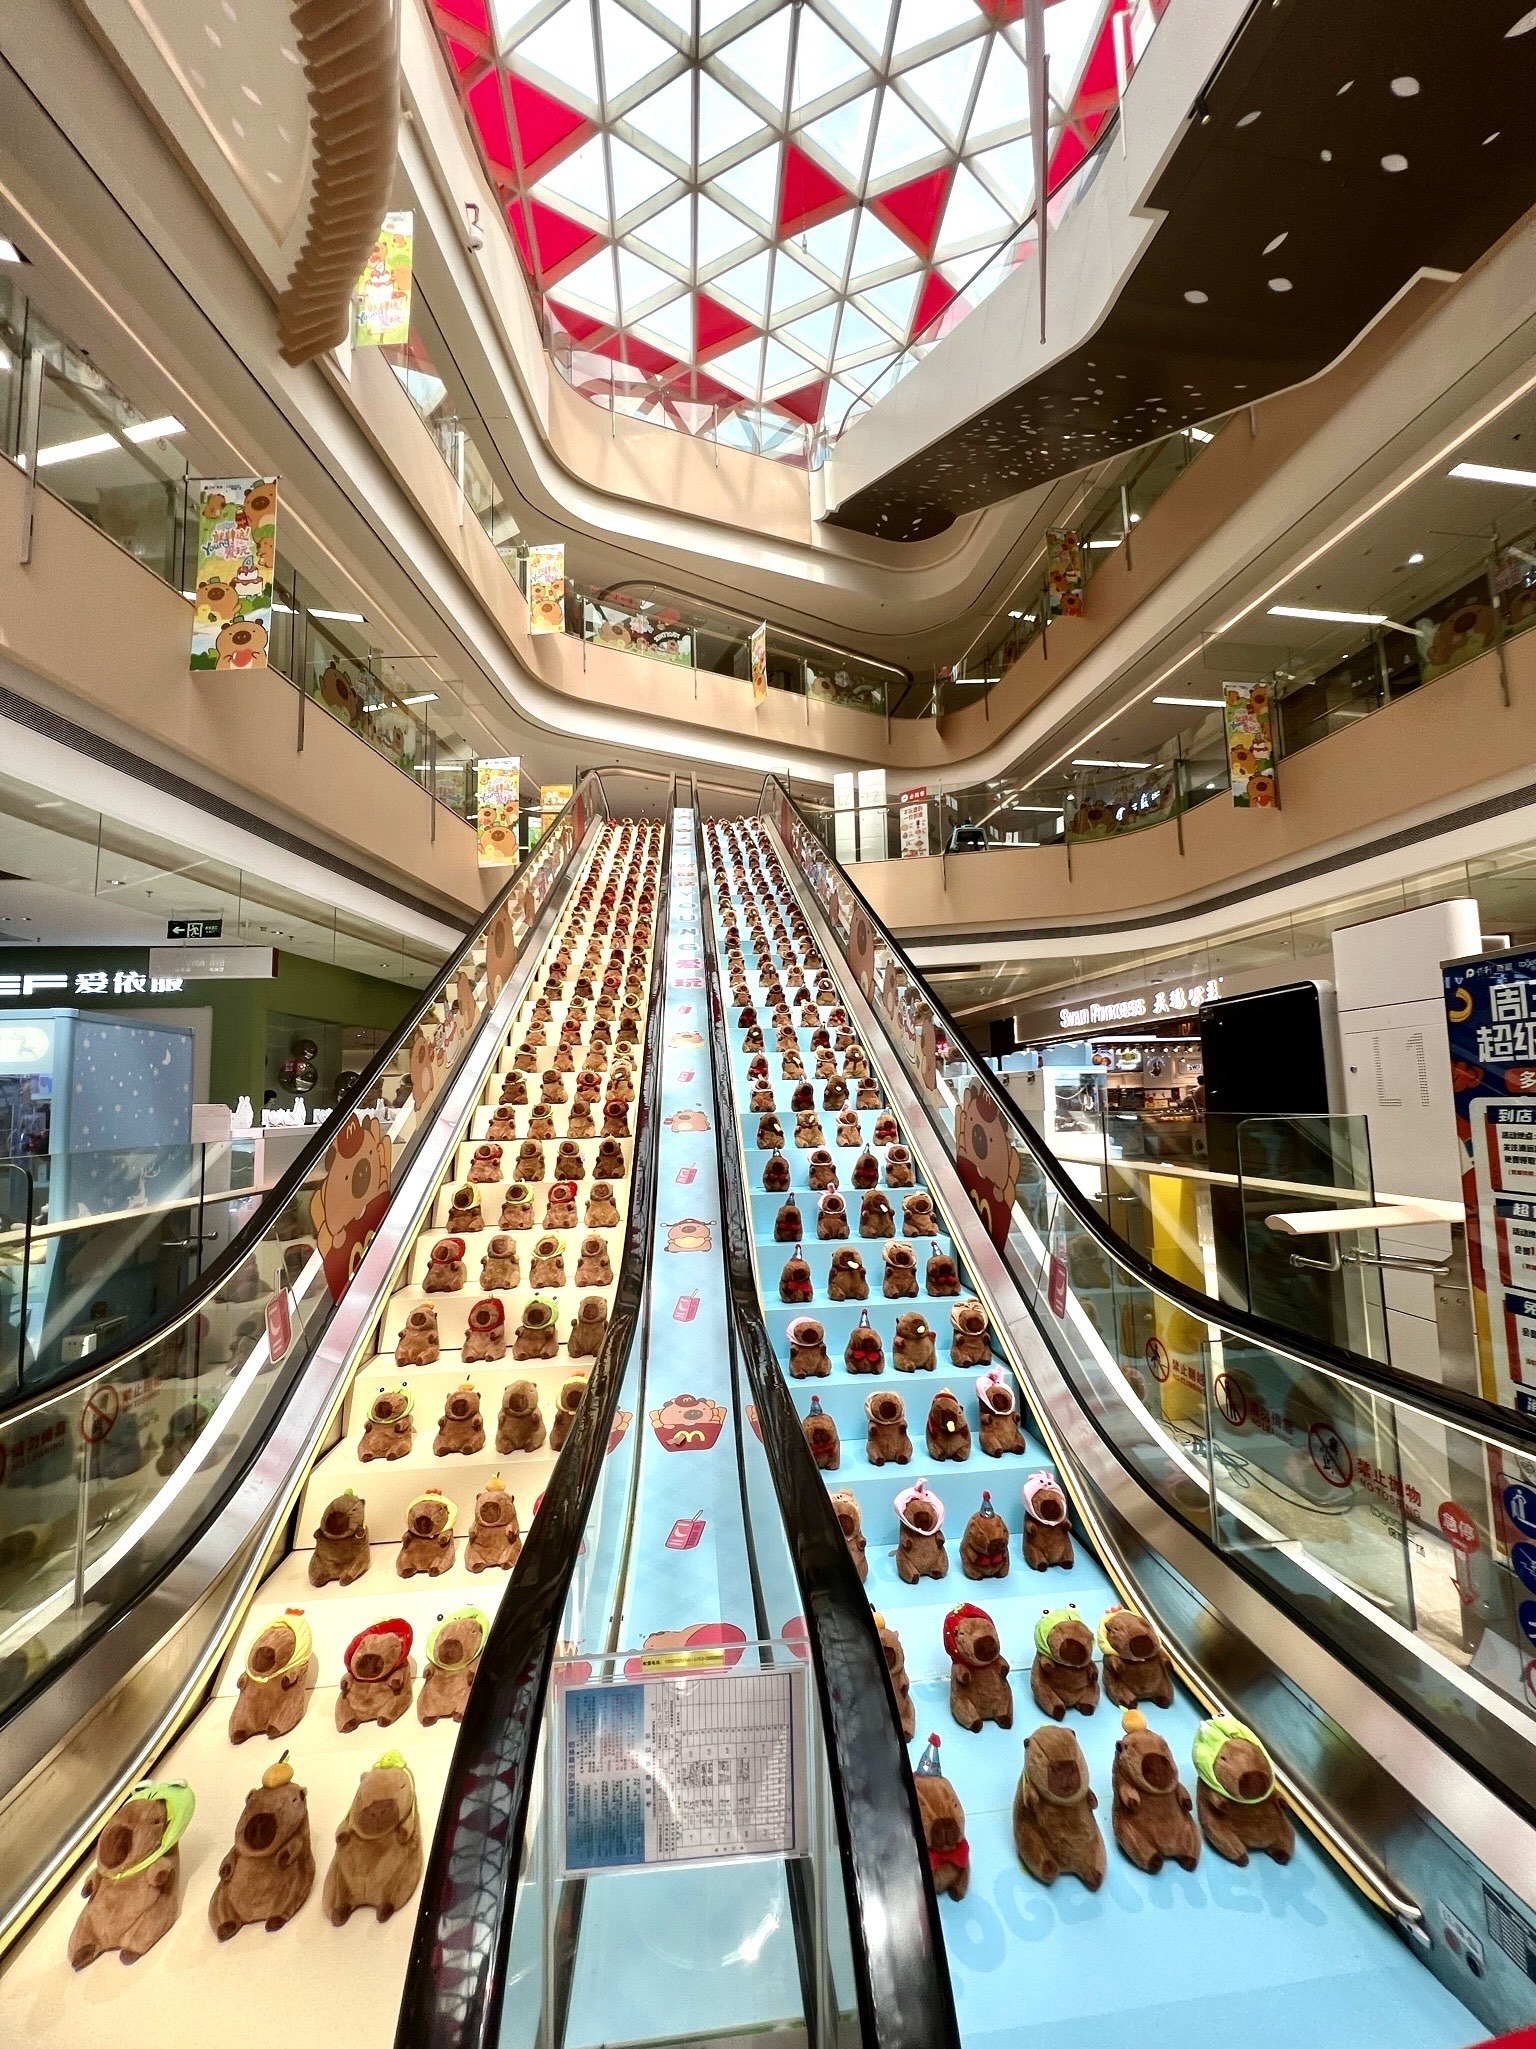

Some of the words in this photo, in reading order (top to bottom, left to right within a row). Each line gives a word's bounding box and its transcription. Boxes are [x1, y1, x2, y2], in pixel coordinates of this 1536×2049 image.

[202, 539, 230, 556] Young
[1059, 1008, 1090, 1029] Swan
[1372, 1032, 1430, 1107] L1
[1512, 1203, 1536, 1218] 超
